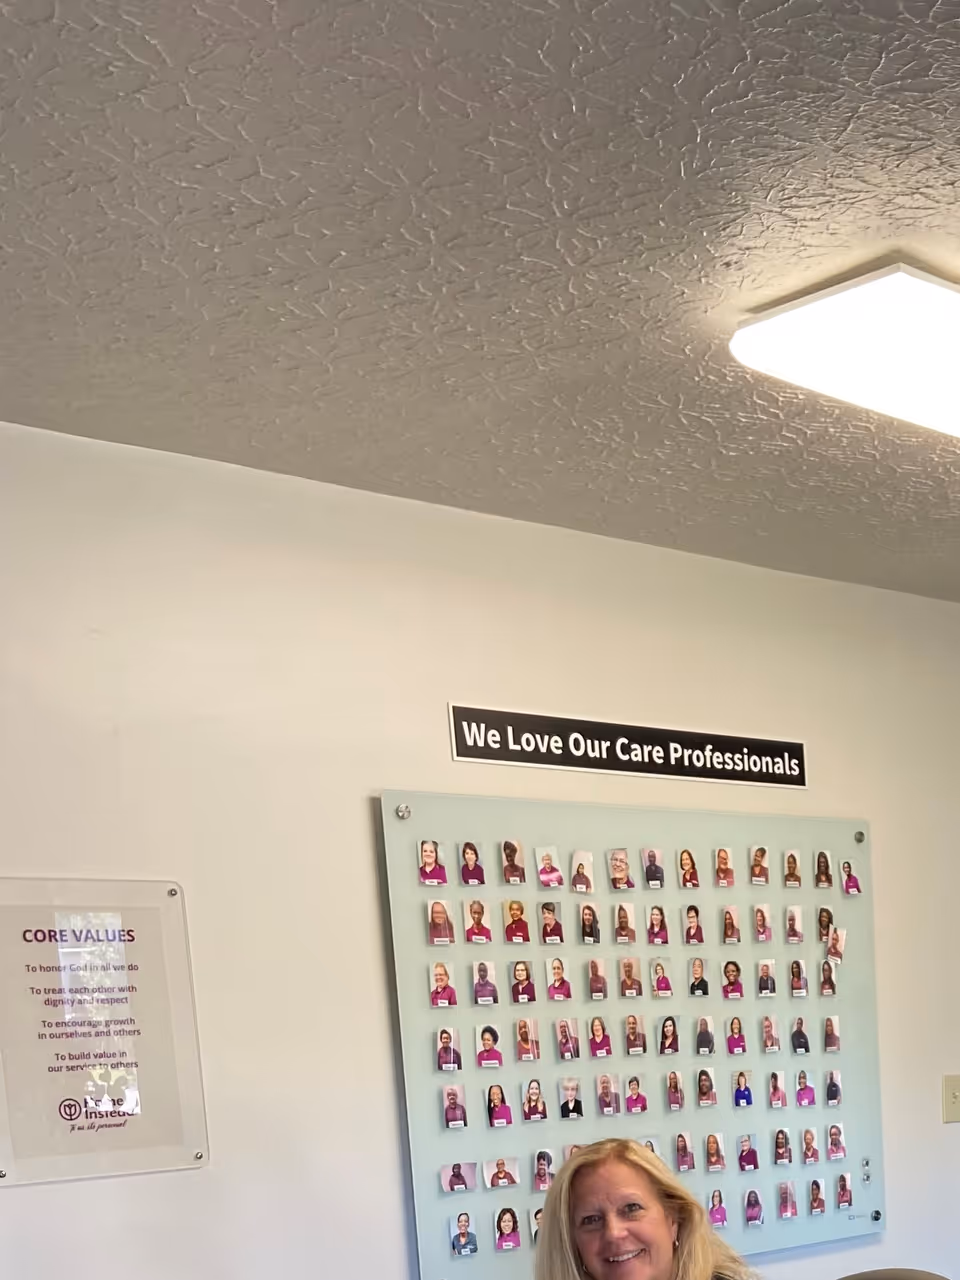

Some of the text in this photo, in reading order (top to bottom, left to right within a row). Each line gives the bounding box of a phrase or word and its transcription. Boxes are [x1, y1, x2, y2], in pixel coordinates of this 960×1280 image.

[462, 720, 800, 777] We Love Our Care Professionals
[22, 929, 136, 943] CORE VALUES
[25, 964, 37, 973] To
[39, 964, 66, 973] honor
[69, 963, 87, 972] God
[90, 963, 99, 971] in
[100, 963, 111, 971] all
[128, 963, 139, 971] do
[30, 984, 138, 995] To treat each other with
[44, 995, 128, 1008] dignity and respect
[41, 1017, 136, 1029] To encourage growth
[38, 1028, 141, 1040] in ourselves and others
[54, 1050, 128, 1061] To build value in
[47, 1065, 63, 1073] our
[110, 1061, 139, 1070] others
